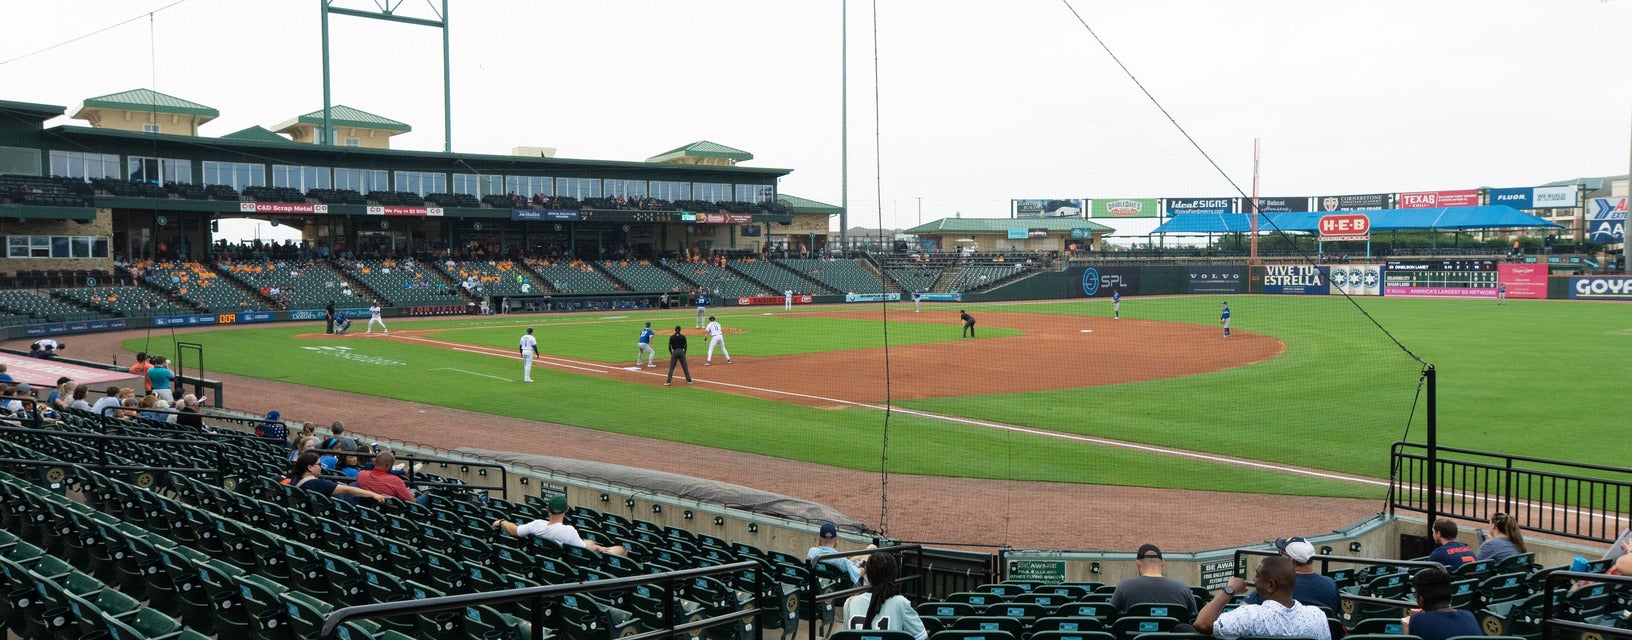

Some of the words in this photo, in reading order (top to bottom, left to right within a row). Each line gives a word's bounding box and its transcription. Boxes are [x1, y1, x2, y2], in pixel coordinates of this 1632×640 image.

[1170, 200, 1199, 209] Ideal
[1199, 200, 1228, 208] SIGNS
[1404, 195, 1435, 205] TEXAS
[1266, 266, 1295, 276] VIVE
[1298, 266, 1314, 276] TU
[1101, 275, 1127, 288] SPL
[409, 305, 467, 313] FORTIFIED
